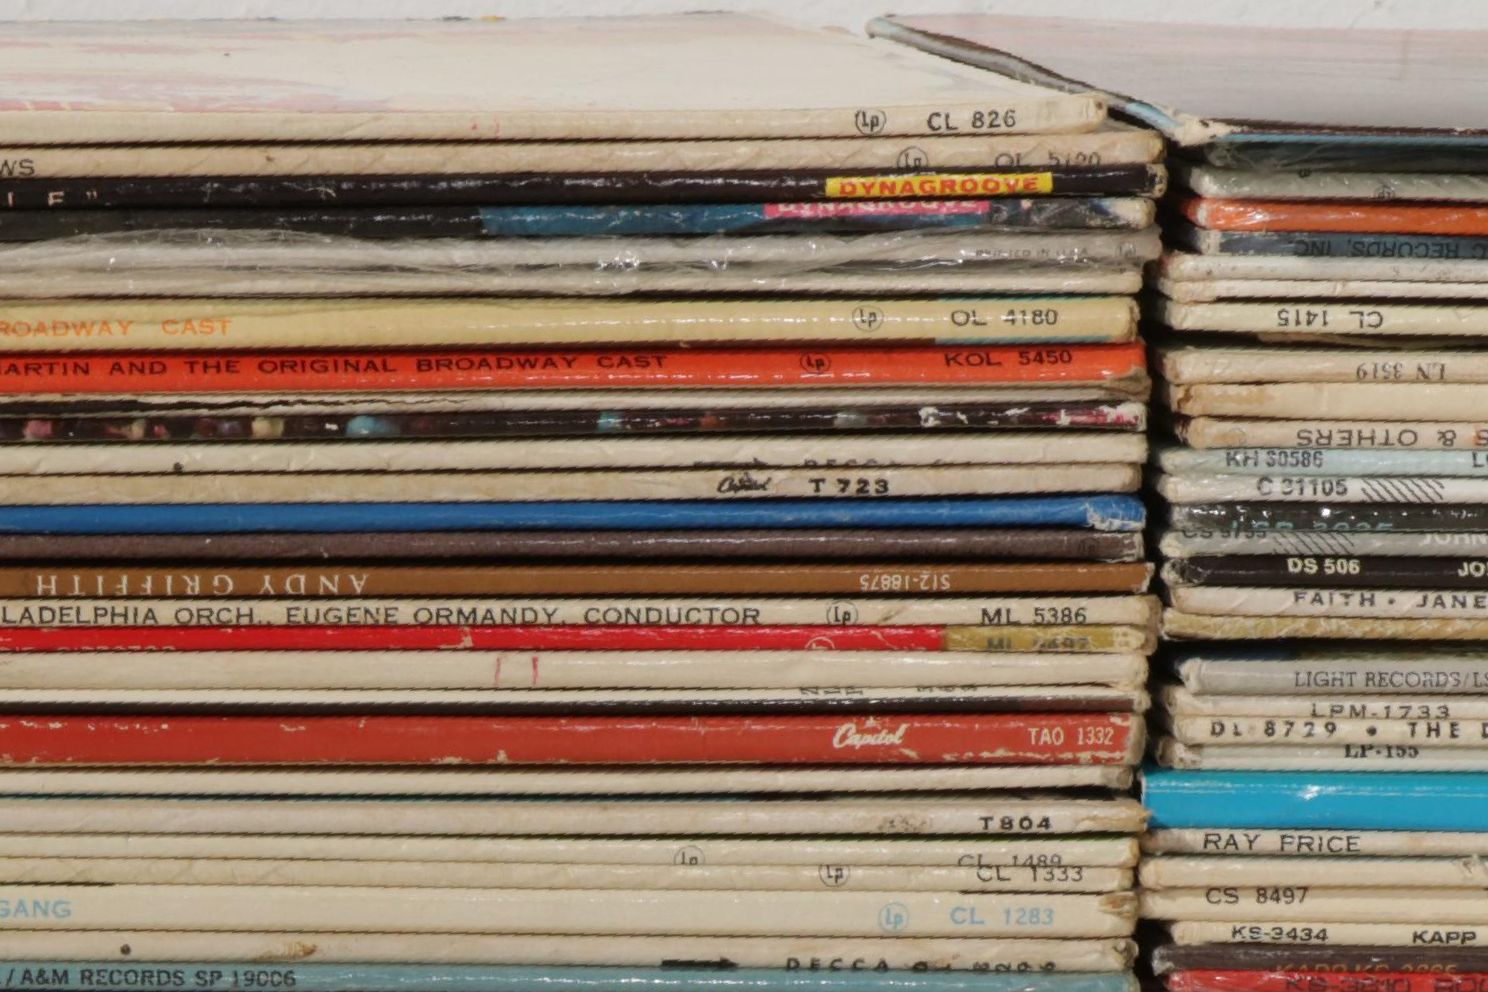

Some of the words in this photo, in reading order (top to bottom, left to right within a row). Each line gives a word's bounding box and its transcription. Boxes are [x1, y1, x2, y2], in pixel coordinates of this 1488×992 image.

[927, 111, 958, 132] CL
[971, 108, 1017, 130] 826
[838, 176, 1039, 195] DYNAGROOVE
[162, 319, 232, 336] CAST
[951, 308, 987, 326] OL
[1002, 308, 1058, 326] 4180
[110, 359, 167, 376] AND
[184, 358, 240, 375] THE
[257, 357, 398, 375] ORIGINAL
[416, 356, 580, 372] BROADWAY
[596, 354, 668, 370] CAST
[944, 350, 1002, 366] KOL
[1018, 348, 1073, 366] 5450
[1287, 558, 1318, 572] DS
[1324, 558, 1360, 575] 506
[37, 574, 233, 596] GRIFFITH
[260, 574, 368, 596] ANDY
[1293, 592, 1376, 606] FAITH
[286, 608, 400, 625] EUGENE
[584, 608, 760, 624] CONDUCTOR
[982, 608, 1021, 624] ML
[1033, 607, 1088, 624] 5386
[832, 723, 908, 749] Capitol
[1029, 727, 1065, 745] TAO
[1076, 727, 1114, 747] 1332
[1203, 834, 1260, 852] RAY
[1279, 835, 1361, 853] PRICE
[1206, 888, 1239, 905] CS
[1255, 887, 1309, 904] 8497
[950, 907, 985, 925] CL
[1004, 906, 1054, 925] 1283
[1232, 927, 1328, 942] KS-3434
[1412, 931, 1476, 945] KAPP
